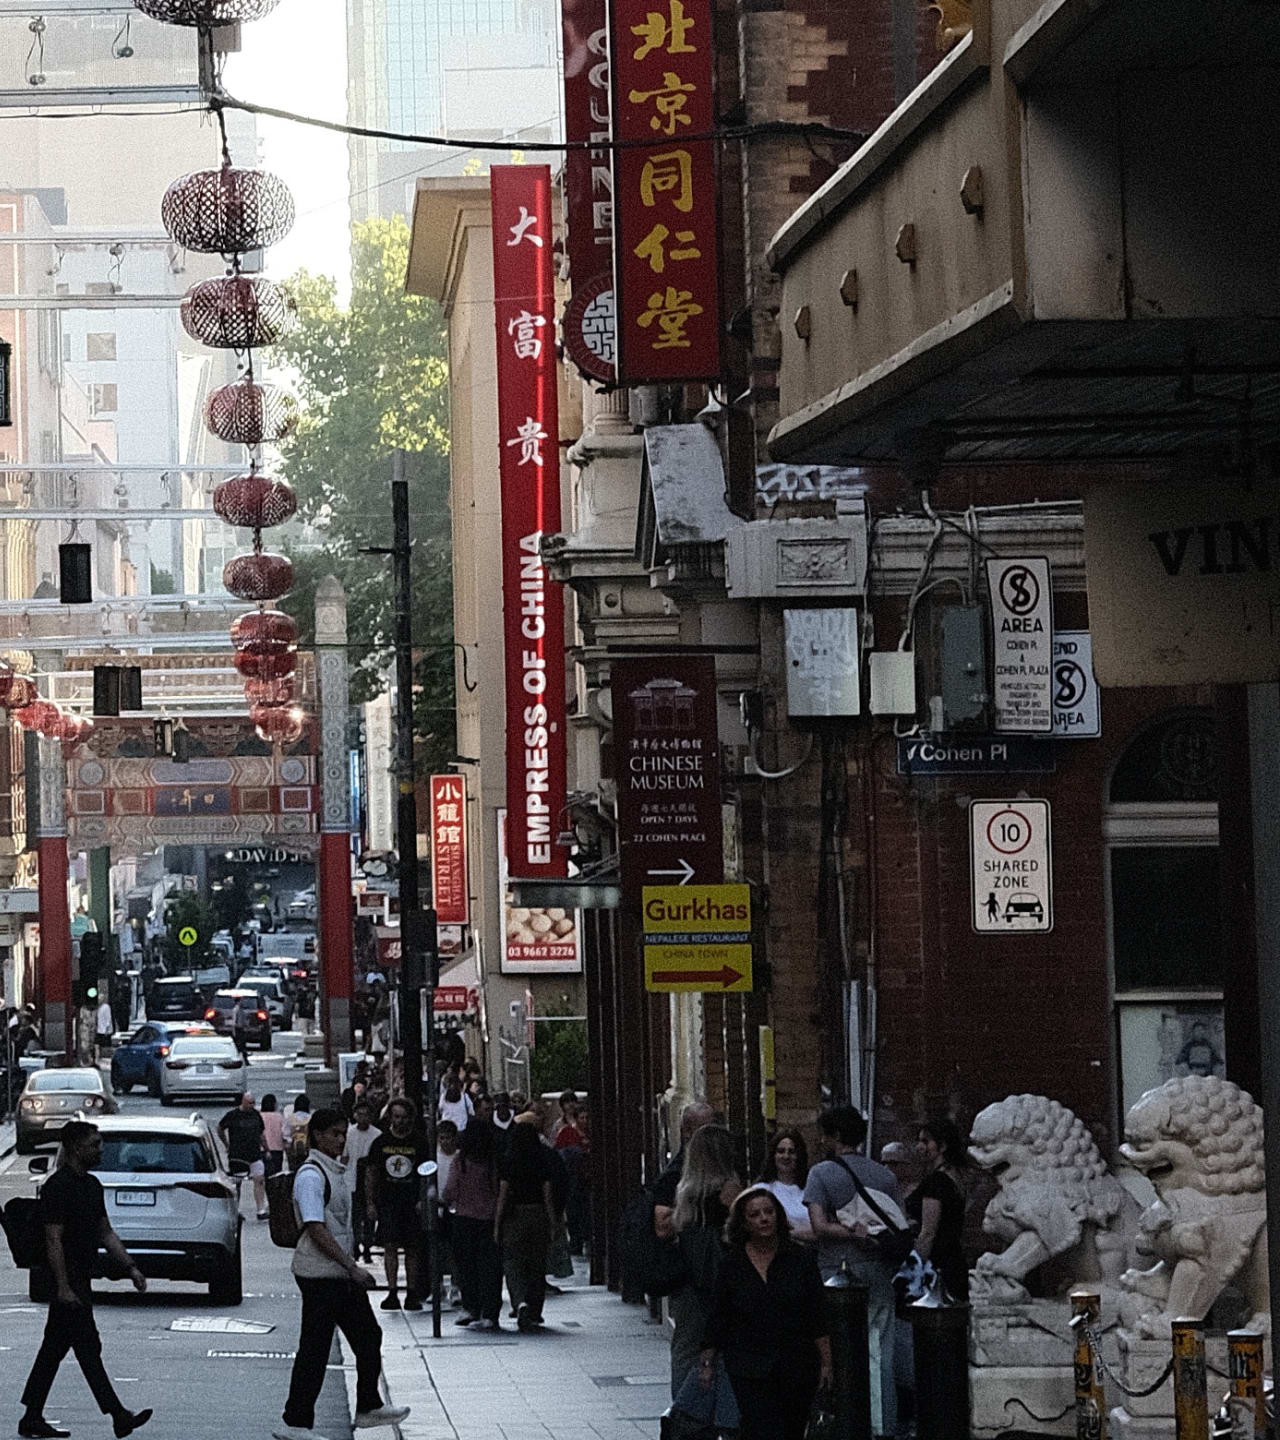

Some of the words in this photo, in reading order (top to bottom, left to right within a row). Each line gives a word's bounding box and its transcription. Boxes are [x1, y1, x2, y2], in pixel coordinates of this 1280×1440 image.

[506, 205, 549, 467] 大富贵
[520, 531, 545, 640] CHINA
[1000, 618, 1044, 633] AREA
[522, 648, 547, 697] OF
[629, 755, 704, 772] CHINESE
[524, 704, 552, 865] EMPRESS
[630, 774, 705, 791] MUSEUM
[640, 816, 665, 824] OPEN
[667, 816, 673, 824] 7
[675, 816, 698, 824] DAYS
[646, 834, 678, 843] COHEN
[680, 834, 706, 842] PLACE
[1000, 823, 1021, 842] 10
[983, 860, 1039, 872] SHARED
[437, 845, 451, 906] STREET
[993, 876, 1029, 888] ZONE
[645, 897, 748, 921] Gurkhas
[508, 945, 521, 957] 03
[523, 945, 548, 957] 9662
[550, 945, 575, 957] 3226
